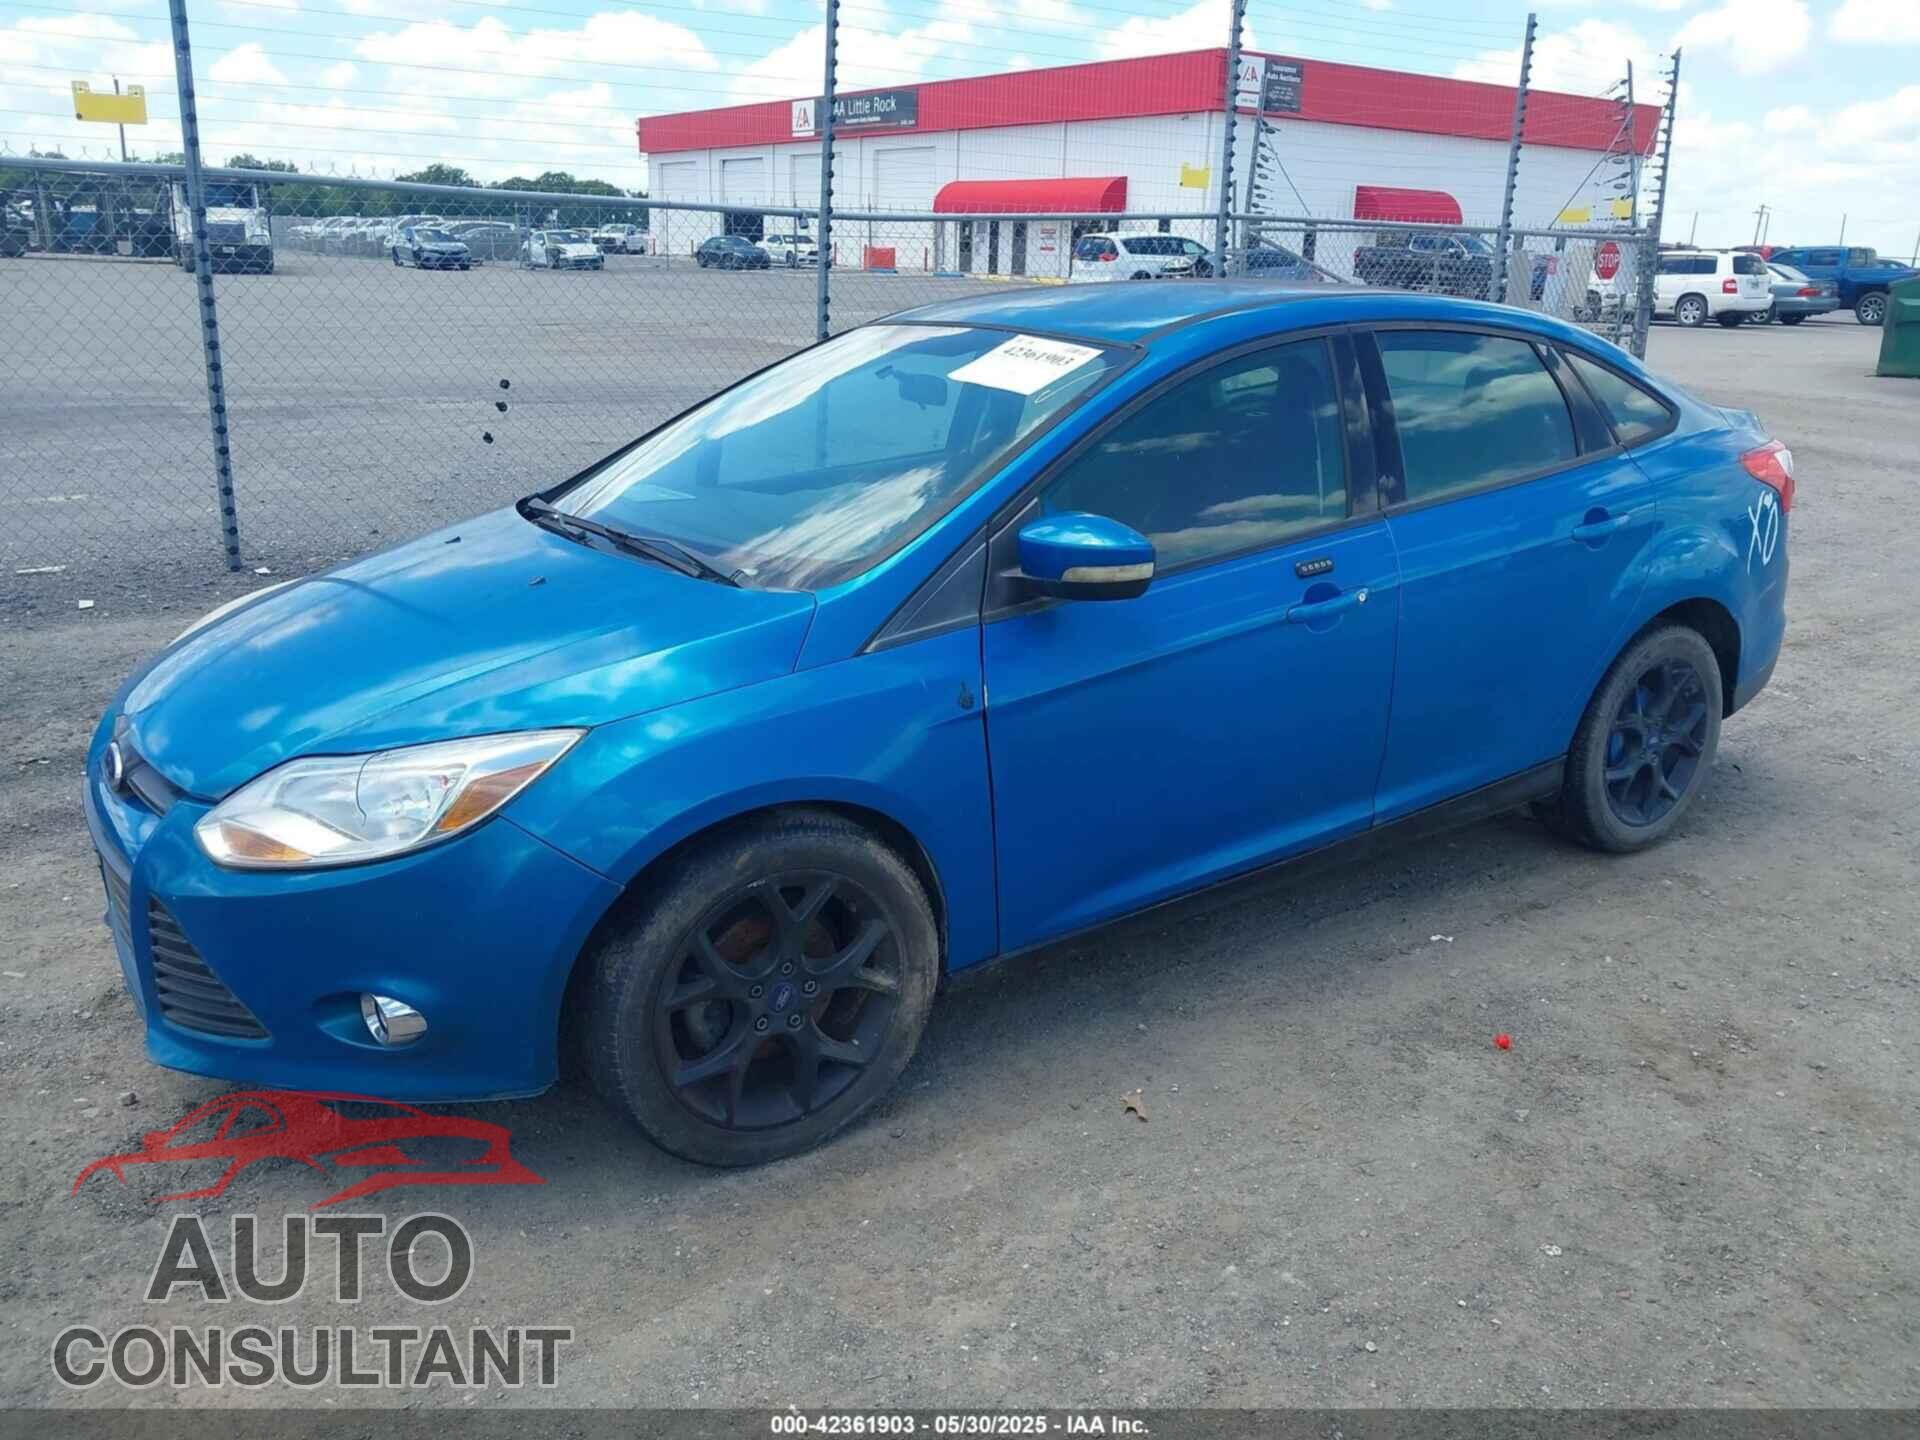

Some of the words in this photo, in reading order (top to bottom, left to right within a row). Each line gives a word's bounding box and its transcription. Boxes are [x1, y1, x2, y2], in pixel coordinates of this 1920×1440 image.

[848, 100, 870, 115] Little
[873, 96, 896, 112] Rock
[1599, 253, 1620, 269] STOP
